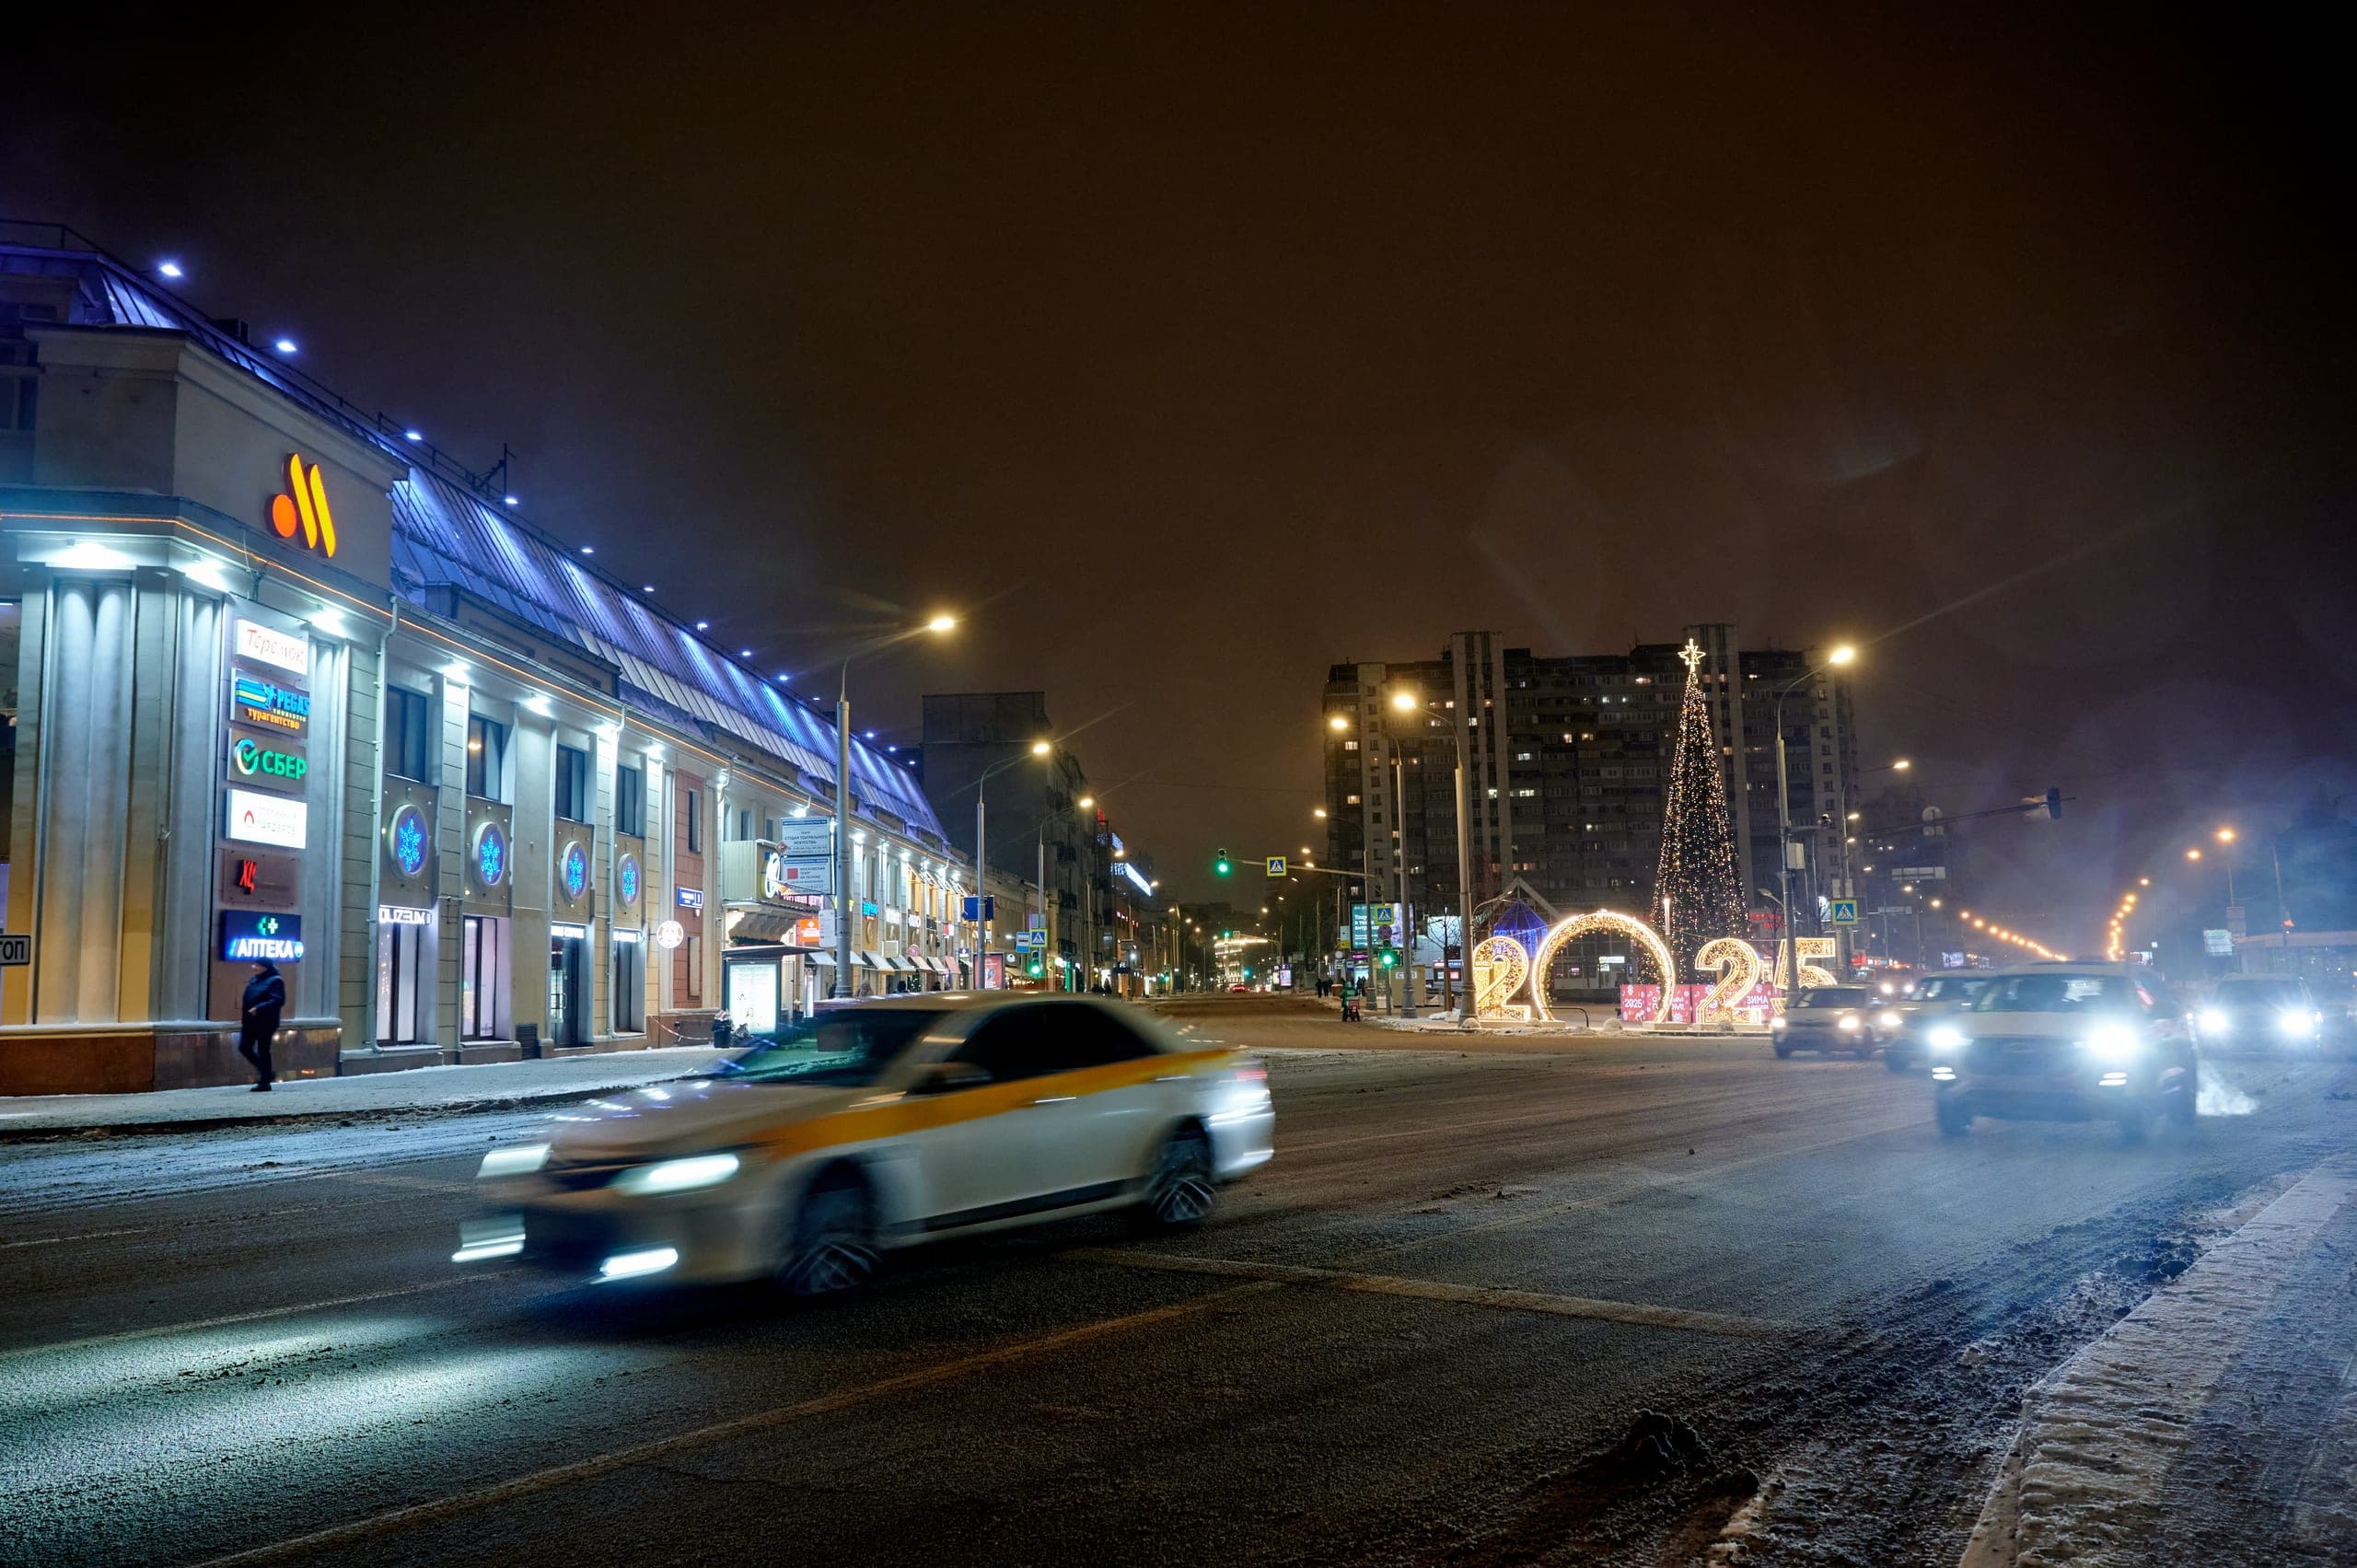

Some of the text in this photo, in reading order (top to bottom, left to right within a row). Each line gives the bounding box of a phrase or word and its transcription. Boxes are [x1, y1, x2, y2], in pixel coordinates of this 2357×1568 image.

[247, 708, 300, 729] турагентство
[261, 750, 308, 780] СБЕР
[0, 941, 25, 960] ОП
[237, 938, 296, 958] АПТЕКА
[1624, 998, 1643, 1009] 2025
[1747, 995, 1769, 1005] ЗИМА
